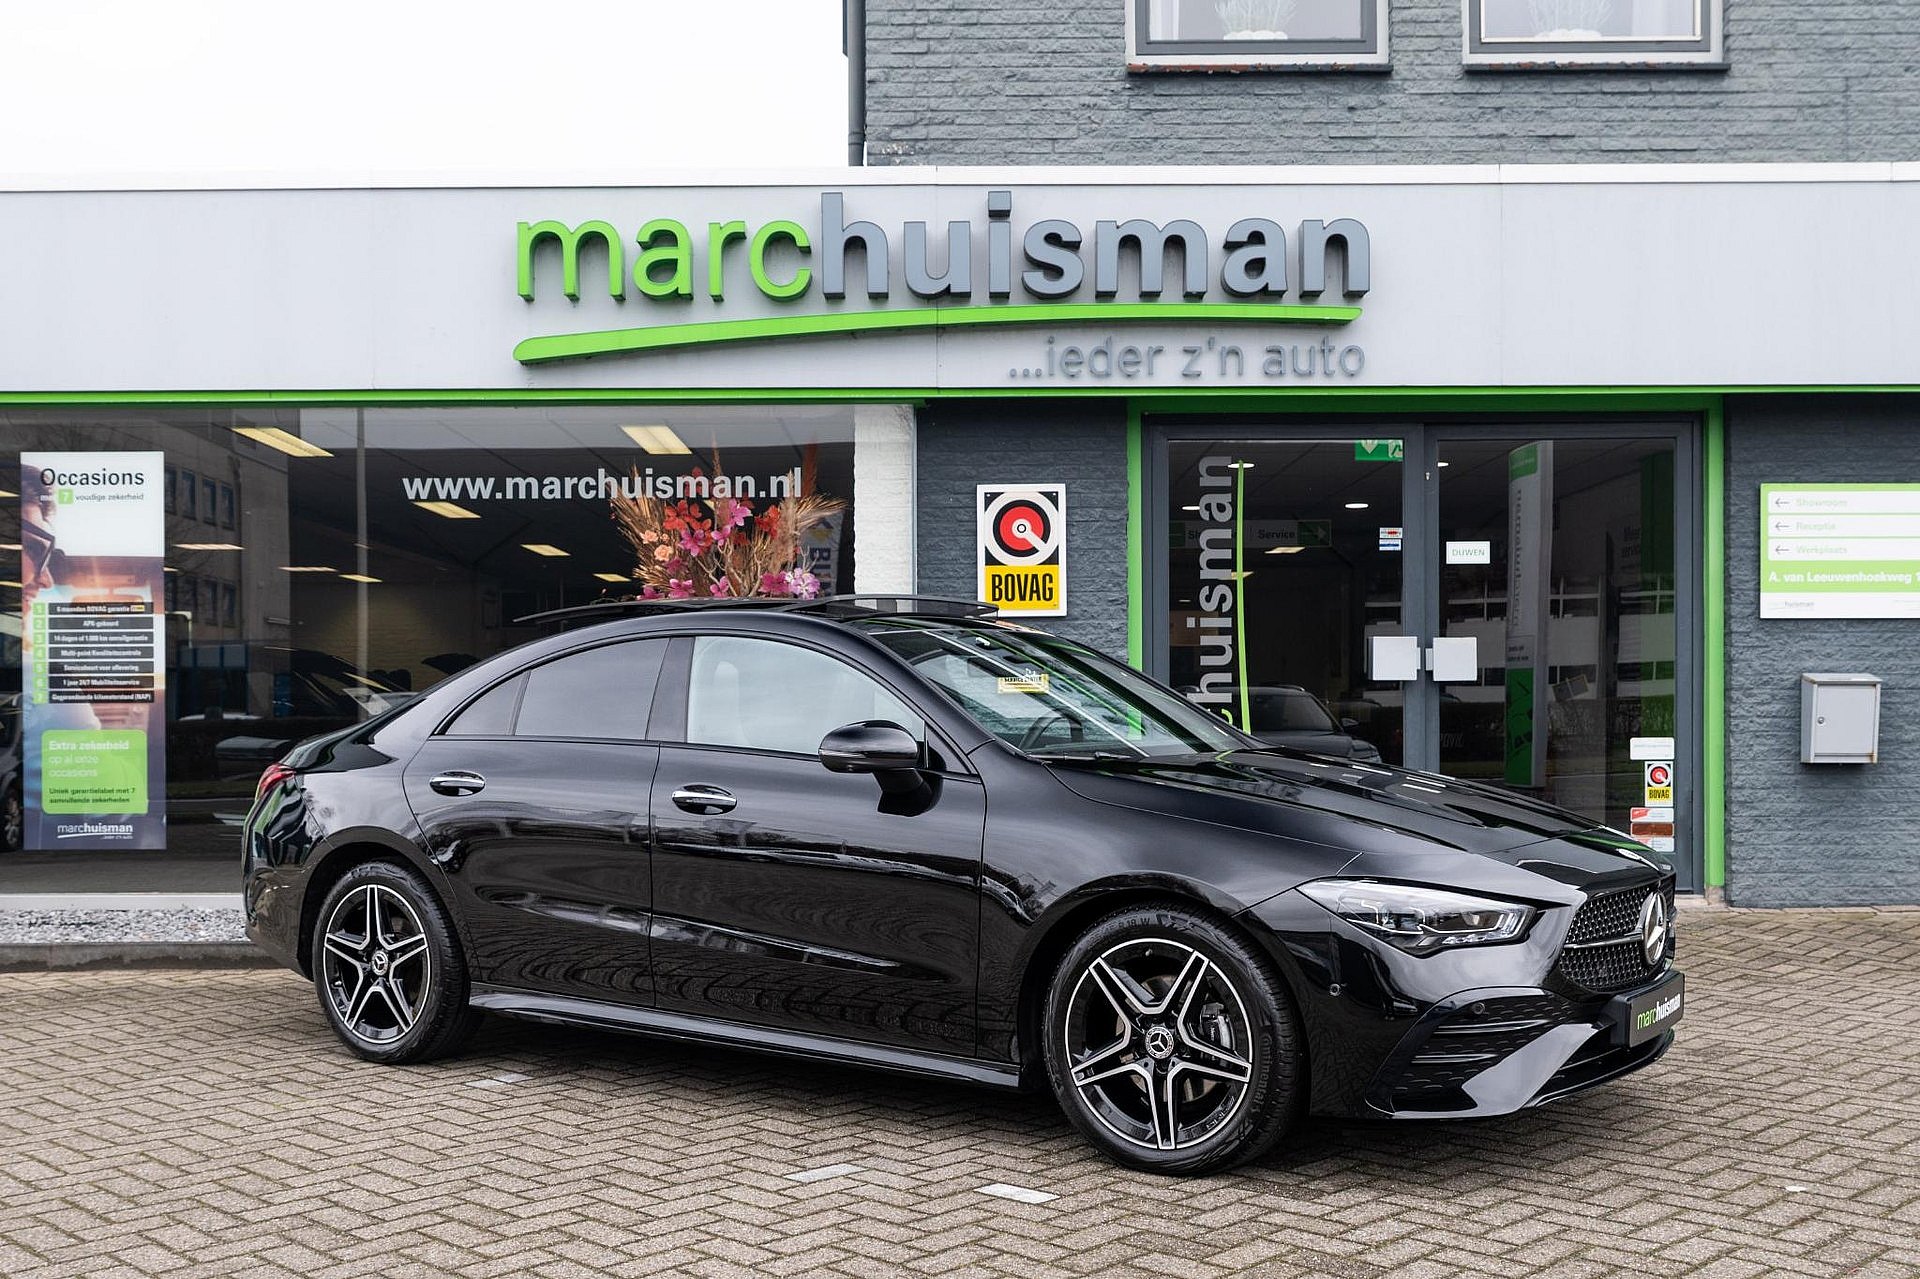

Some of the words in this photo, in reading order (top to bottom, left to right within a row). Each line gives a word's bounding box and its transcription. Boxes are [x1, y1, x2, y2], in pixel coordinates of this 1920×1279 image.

[516, 190, 1371, 303] marchuisman
[1180, 336, 1244, 378] z'n
[1265, 336, 1367, 378] auto
[40, 467, 145, 486] Occasions
[402, 466, 803, 501] www.marchuisman.nl
[1257, 529, 1295, 539] Service
[1452, 548, 1486, 557] DUWEN
[1783, 573, 1805, 583] van
[990, 572, 1055, 603] BOVAG
[49, 740, 76, 751] Extra
[78, 740, 129, 751] zekerheid
[1648, 788, 1670, 800] BOVAG
[57, 822, 133, 834] marchuisman
[1637, 993, 1681, 1030] marchuisman
